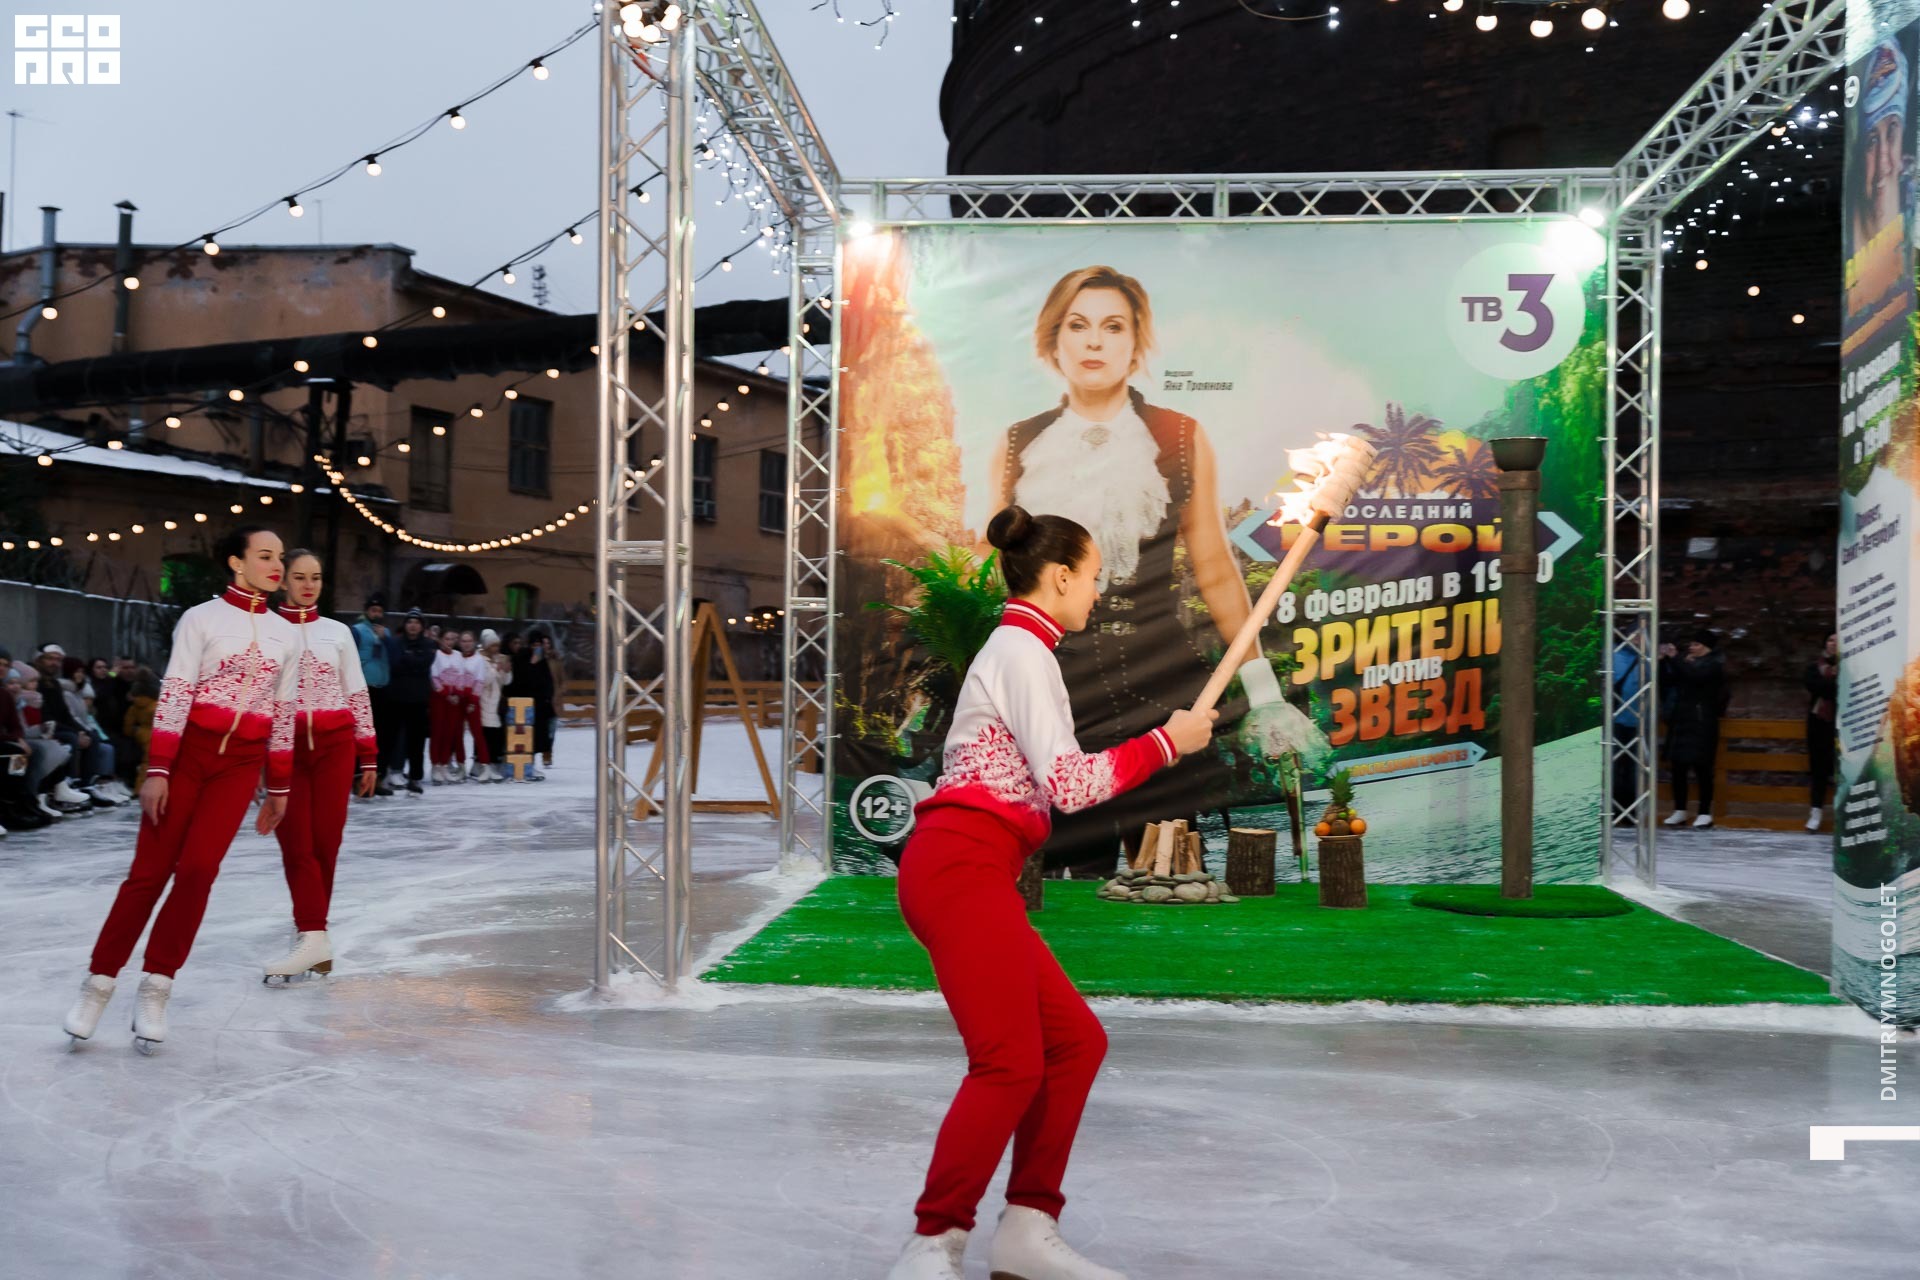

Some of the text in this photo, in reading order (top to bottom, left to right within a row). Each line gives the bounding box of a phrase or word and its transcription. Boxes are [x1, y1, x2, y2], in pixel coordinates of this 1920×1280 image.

[1343, 502, 1473, 519] ОСЛЕДНИЙ
[1304, 575, 1434, 623] февраля
[1442, 571, 1461, 598] в
[1470, 550, 1554, 593] 190
[1362, 656, 1443, 690] ПРОТИВ
[1329, 667, 1486, 747] ЗВЕЗД
[860, 796, 907, 819] 12+
